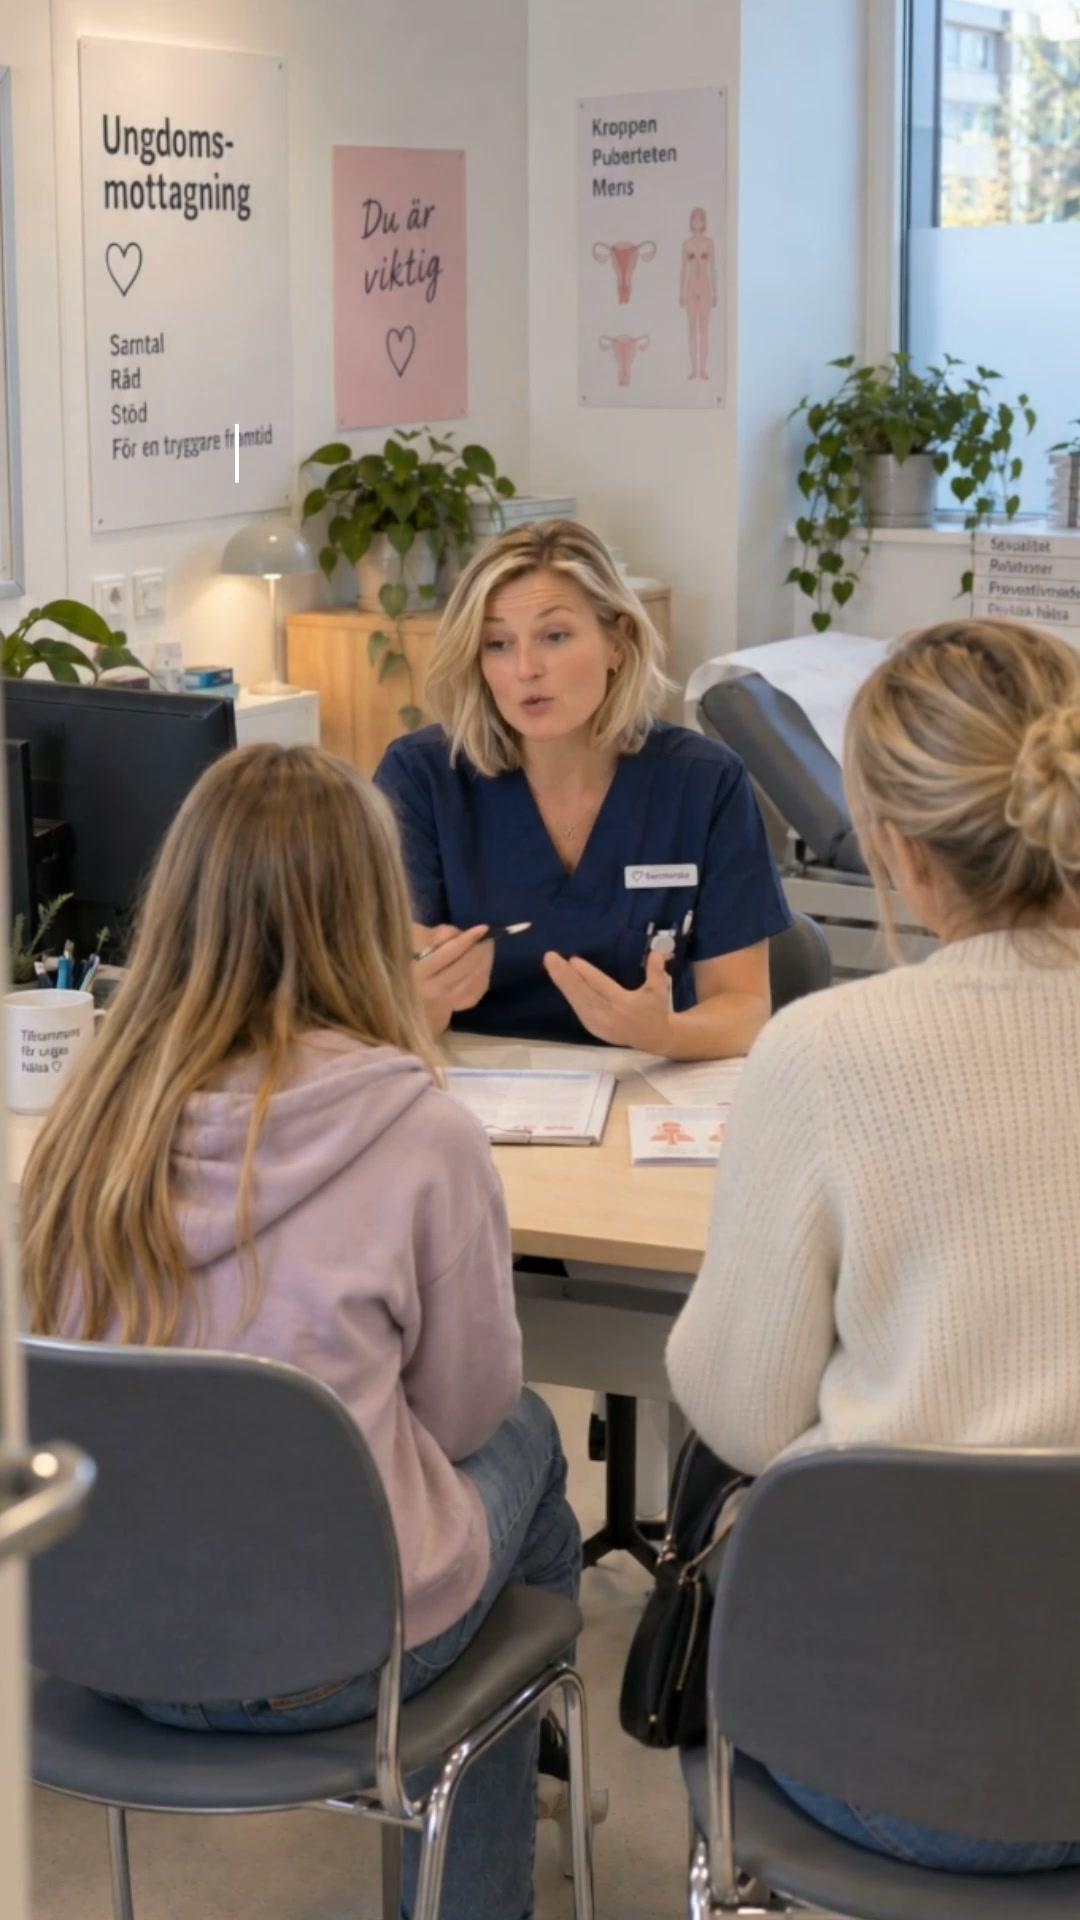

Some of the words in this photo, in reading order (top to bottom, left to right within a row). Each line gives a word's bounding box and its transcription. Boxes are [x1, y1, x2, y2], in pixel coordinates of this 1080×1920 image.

[102, 113, 234, 166] Ungdoms-
[592, 118, 657, 140] Kroppen
[592, 146, 677, 167] Puberteten
[104, 172, 251, 221] mottagning
[592, 178, 634, 197] Mens
[361, 198, 400, 240] Du
[406, 198, 436, 231] är
[365, 248, 444, 304] viktig
[110, 332, 165, 357] Samtal
[110, 367, 141, 390] Råd
[111, 401, 148, 425] Stöd
[112, 437, 137, 460] För
[142, 439, 160, 457] en
[164, 434, 221, 459] tryggare
